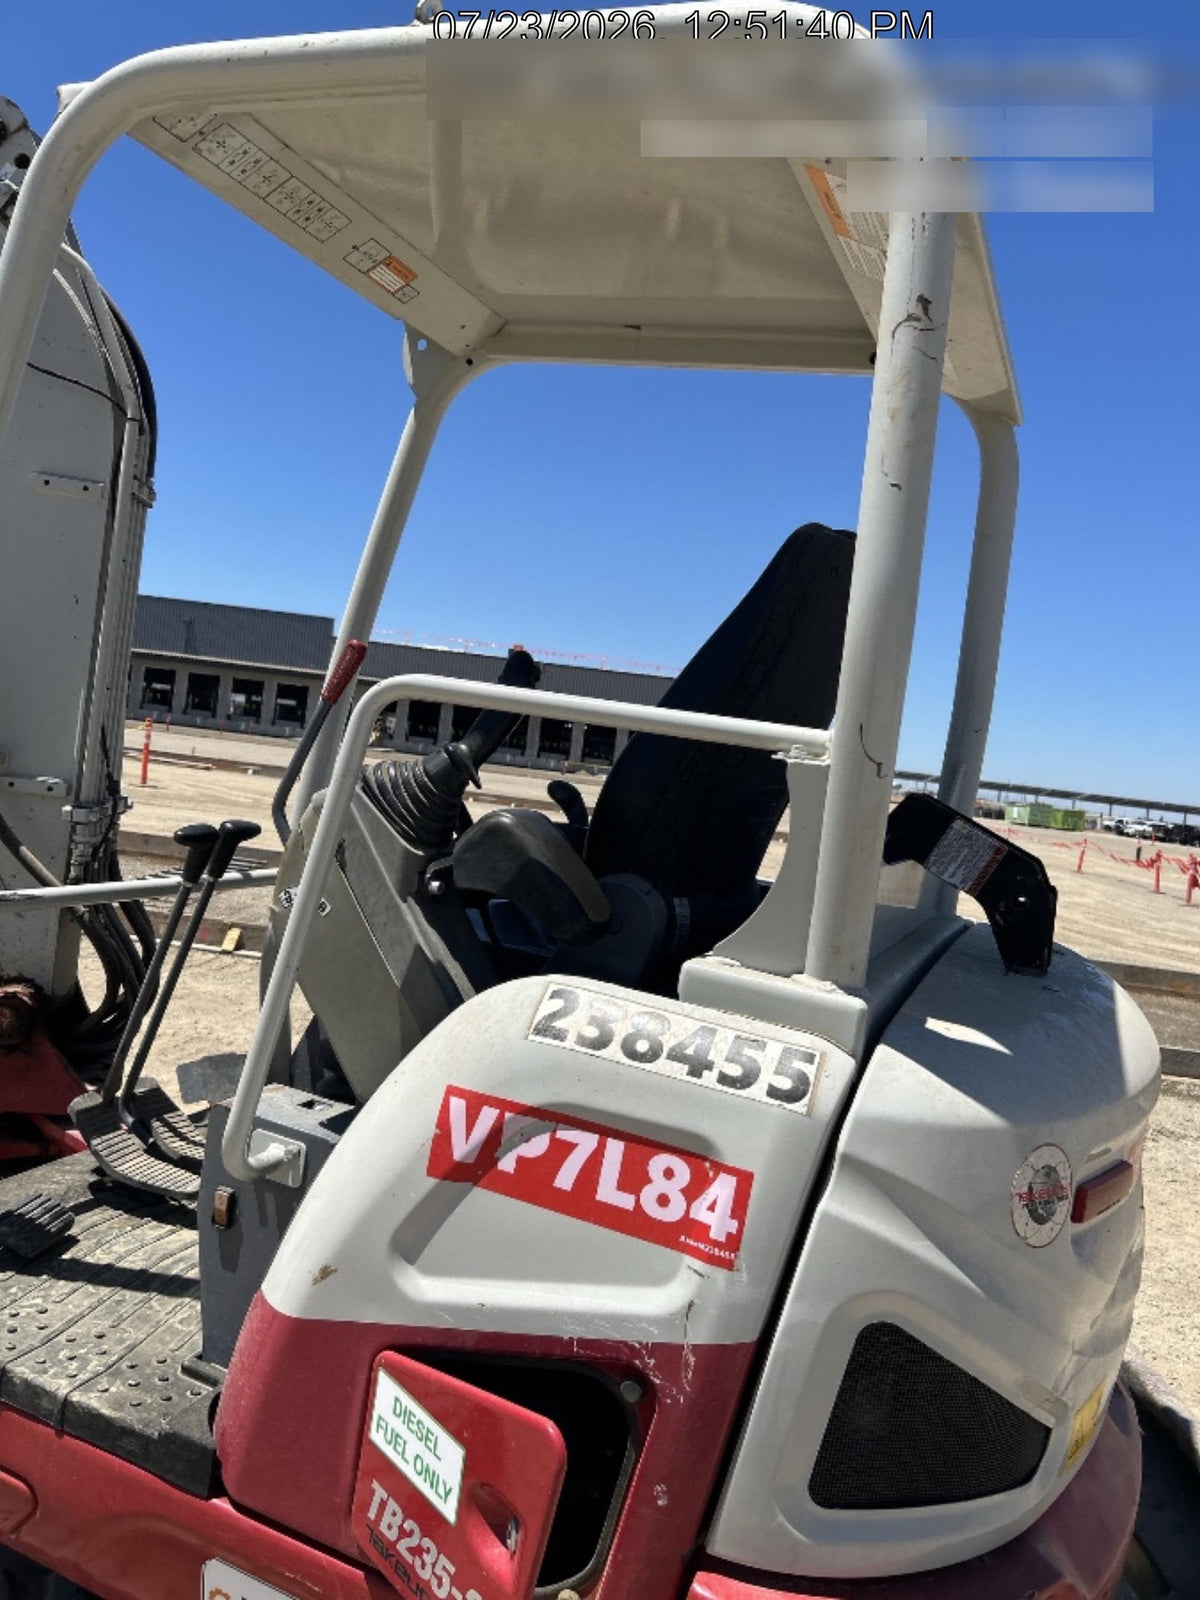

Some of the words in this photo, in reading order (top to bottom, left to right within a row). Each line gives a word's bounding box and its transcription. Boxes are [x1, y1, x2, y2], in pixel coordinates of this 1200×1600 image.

[532, 987, 816, 1106] 238455
[448, 1096, 739, 1243] VP7L84
[375, 1413, 410, 1465] FUEL
[413, 1456, 454, 1505] ONLY
[392, 1395, 442, 1461] DIESEL
